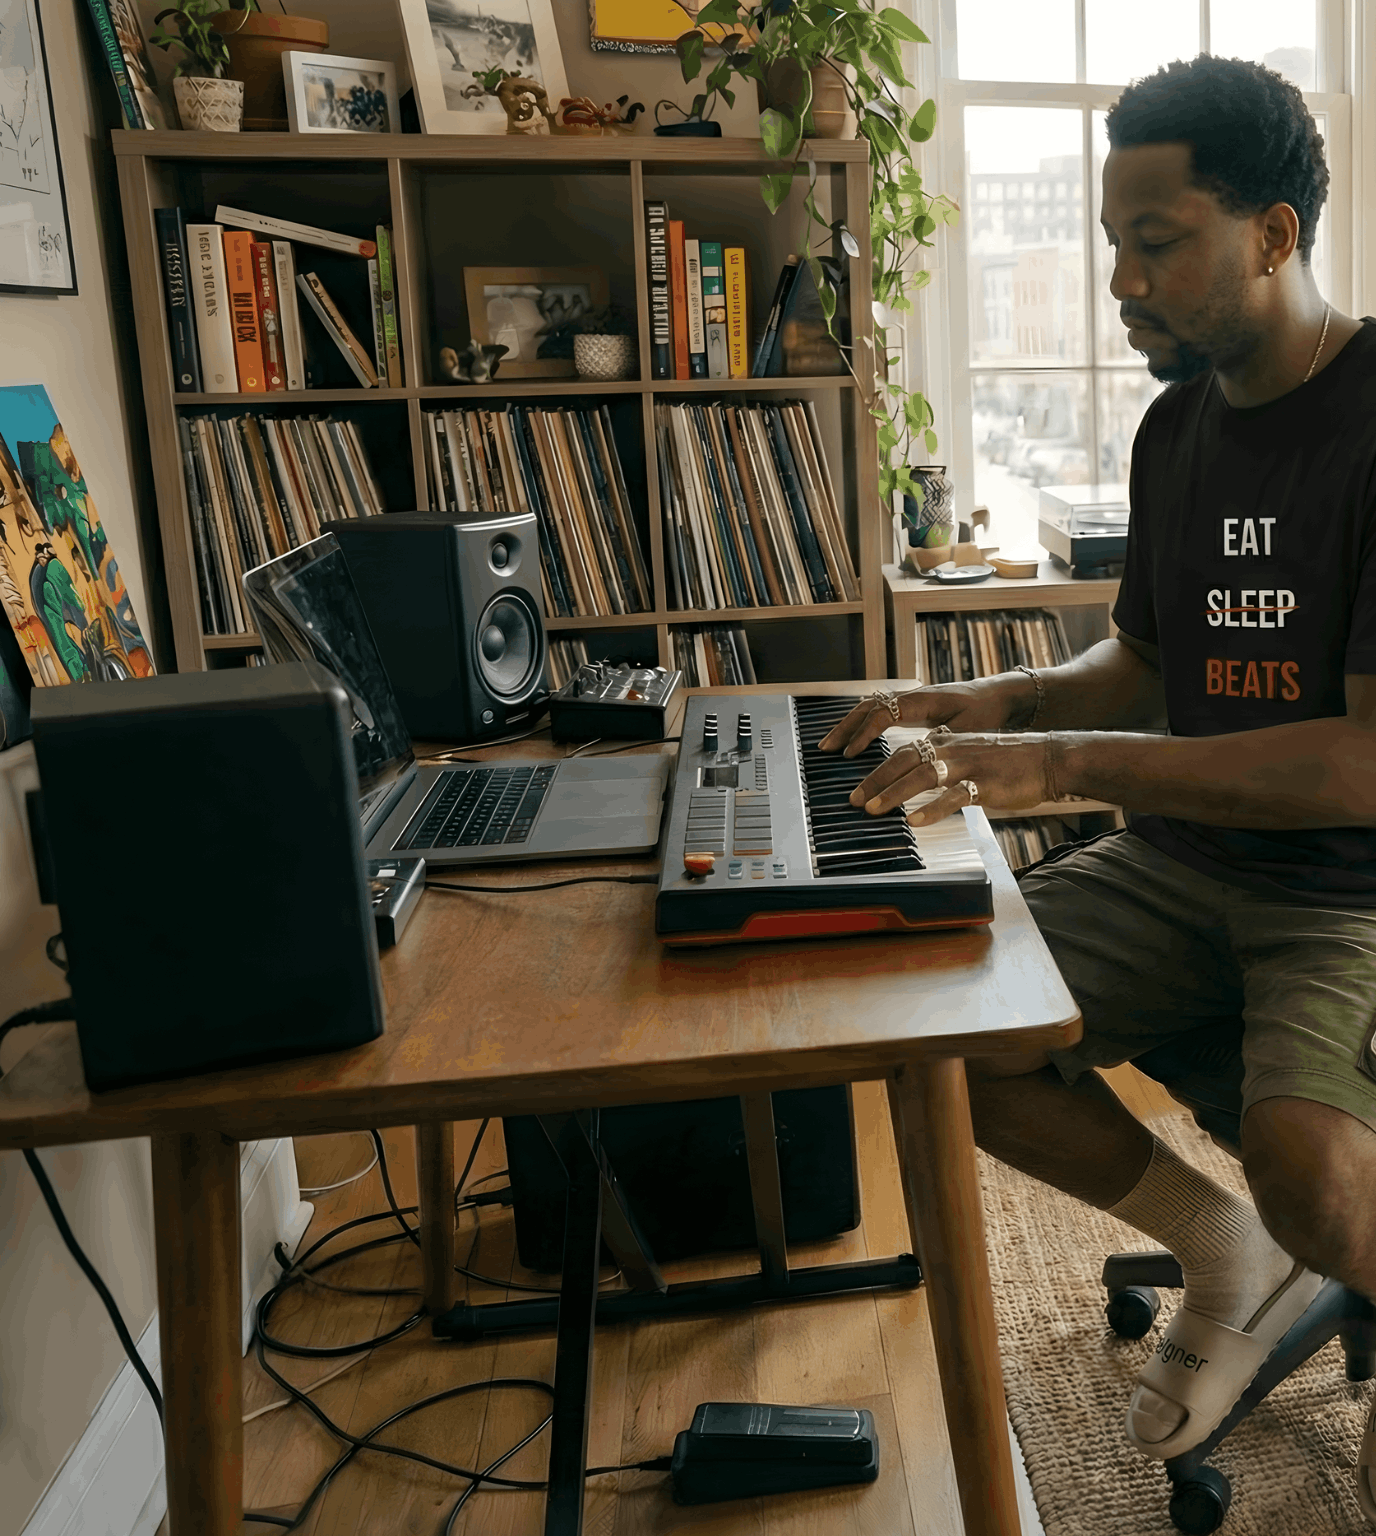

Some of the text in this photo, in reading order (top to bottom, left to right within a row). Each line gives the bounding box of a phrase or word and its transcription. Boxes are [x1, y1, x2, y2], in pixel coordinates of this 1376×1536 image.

[1223, 517, 1277, 556] EAT
[1206, 588, 1297, 628] SLEEP
[1206, 658, 1301, 701] BEATS
